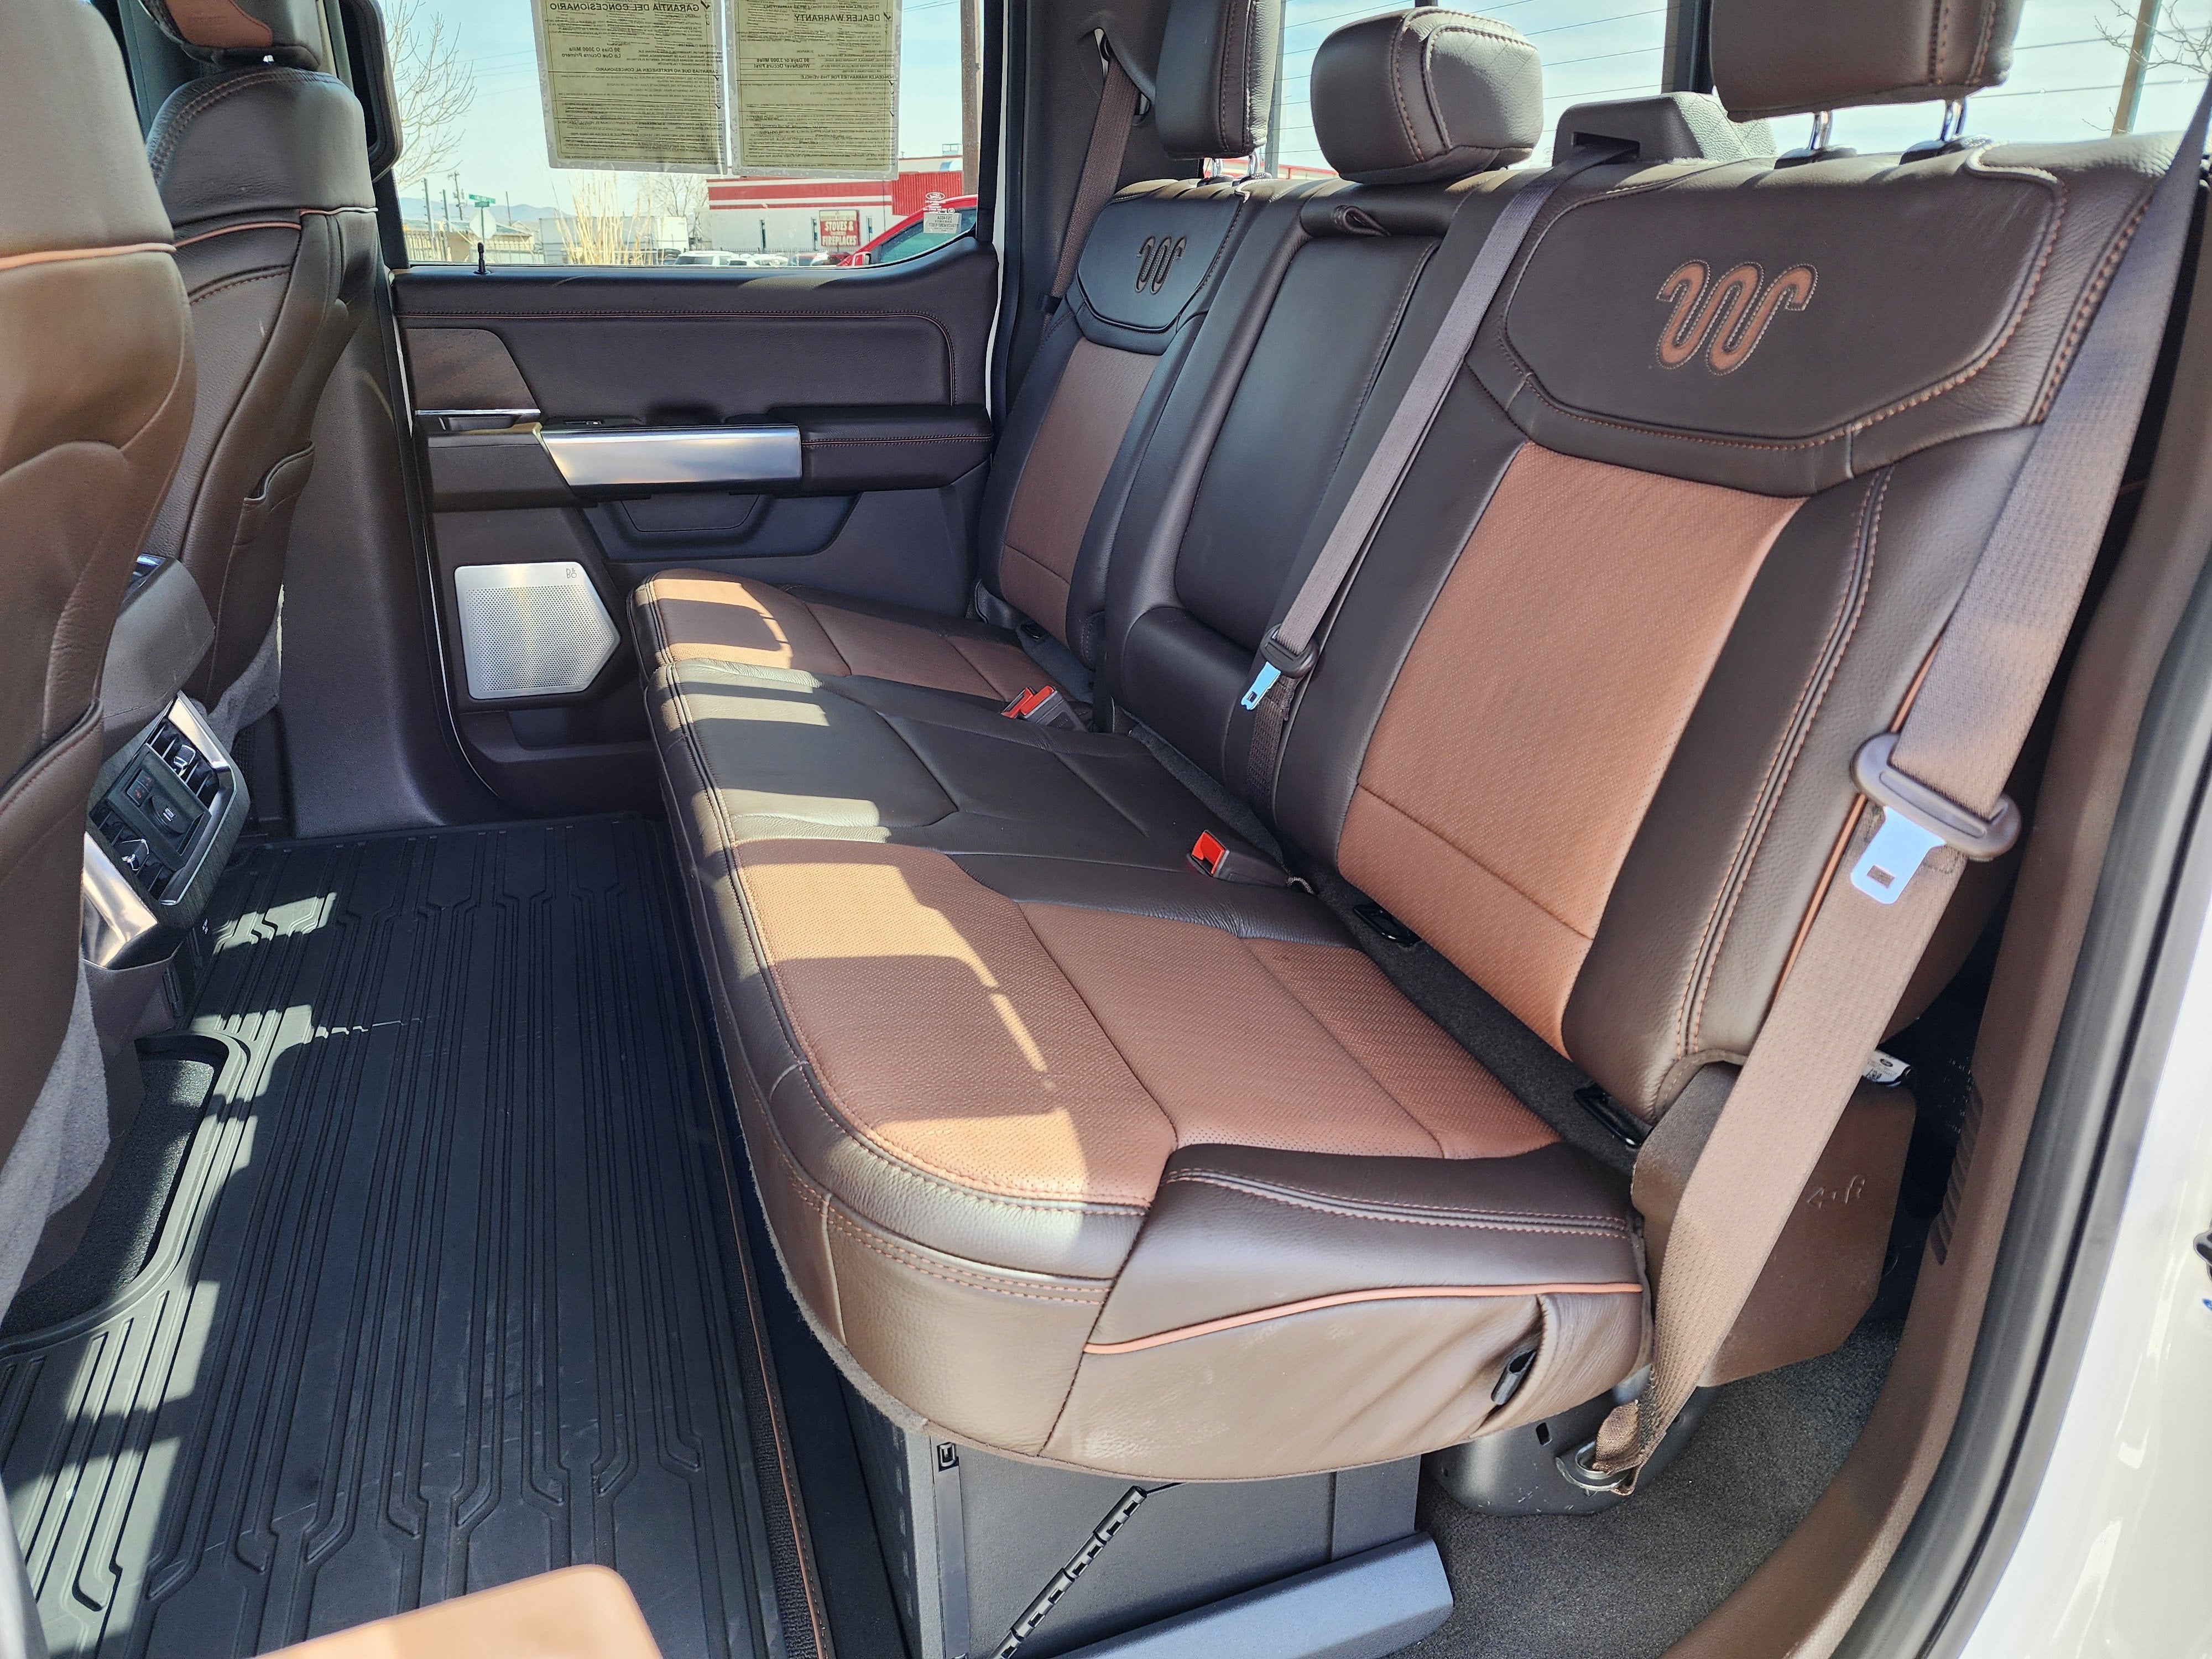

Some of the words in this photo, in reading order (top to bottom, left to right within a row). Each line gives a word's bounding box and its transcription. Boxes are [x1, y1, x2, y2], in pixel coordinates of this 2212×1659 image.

[825, 221, 848, 231] STOVES
[848, 221, 854, 231] &
[822, 234, 857, 246] FIREPLACES
